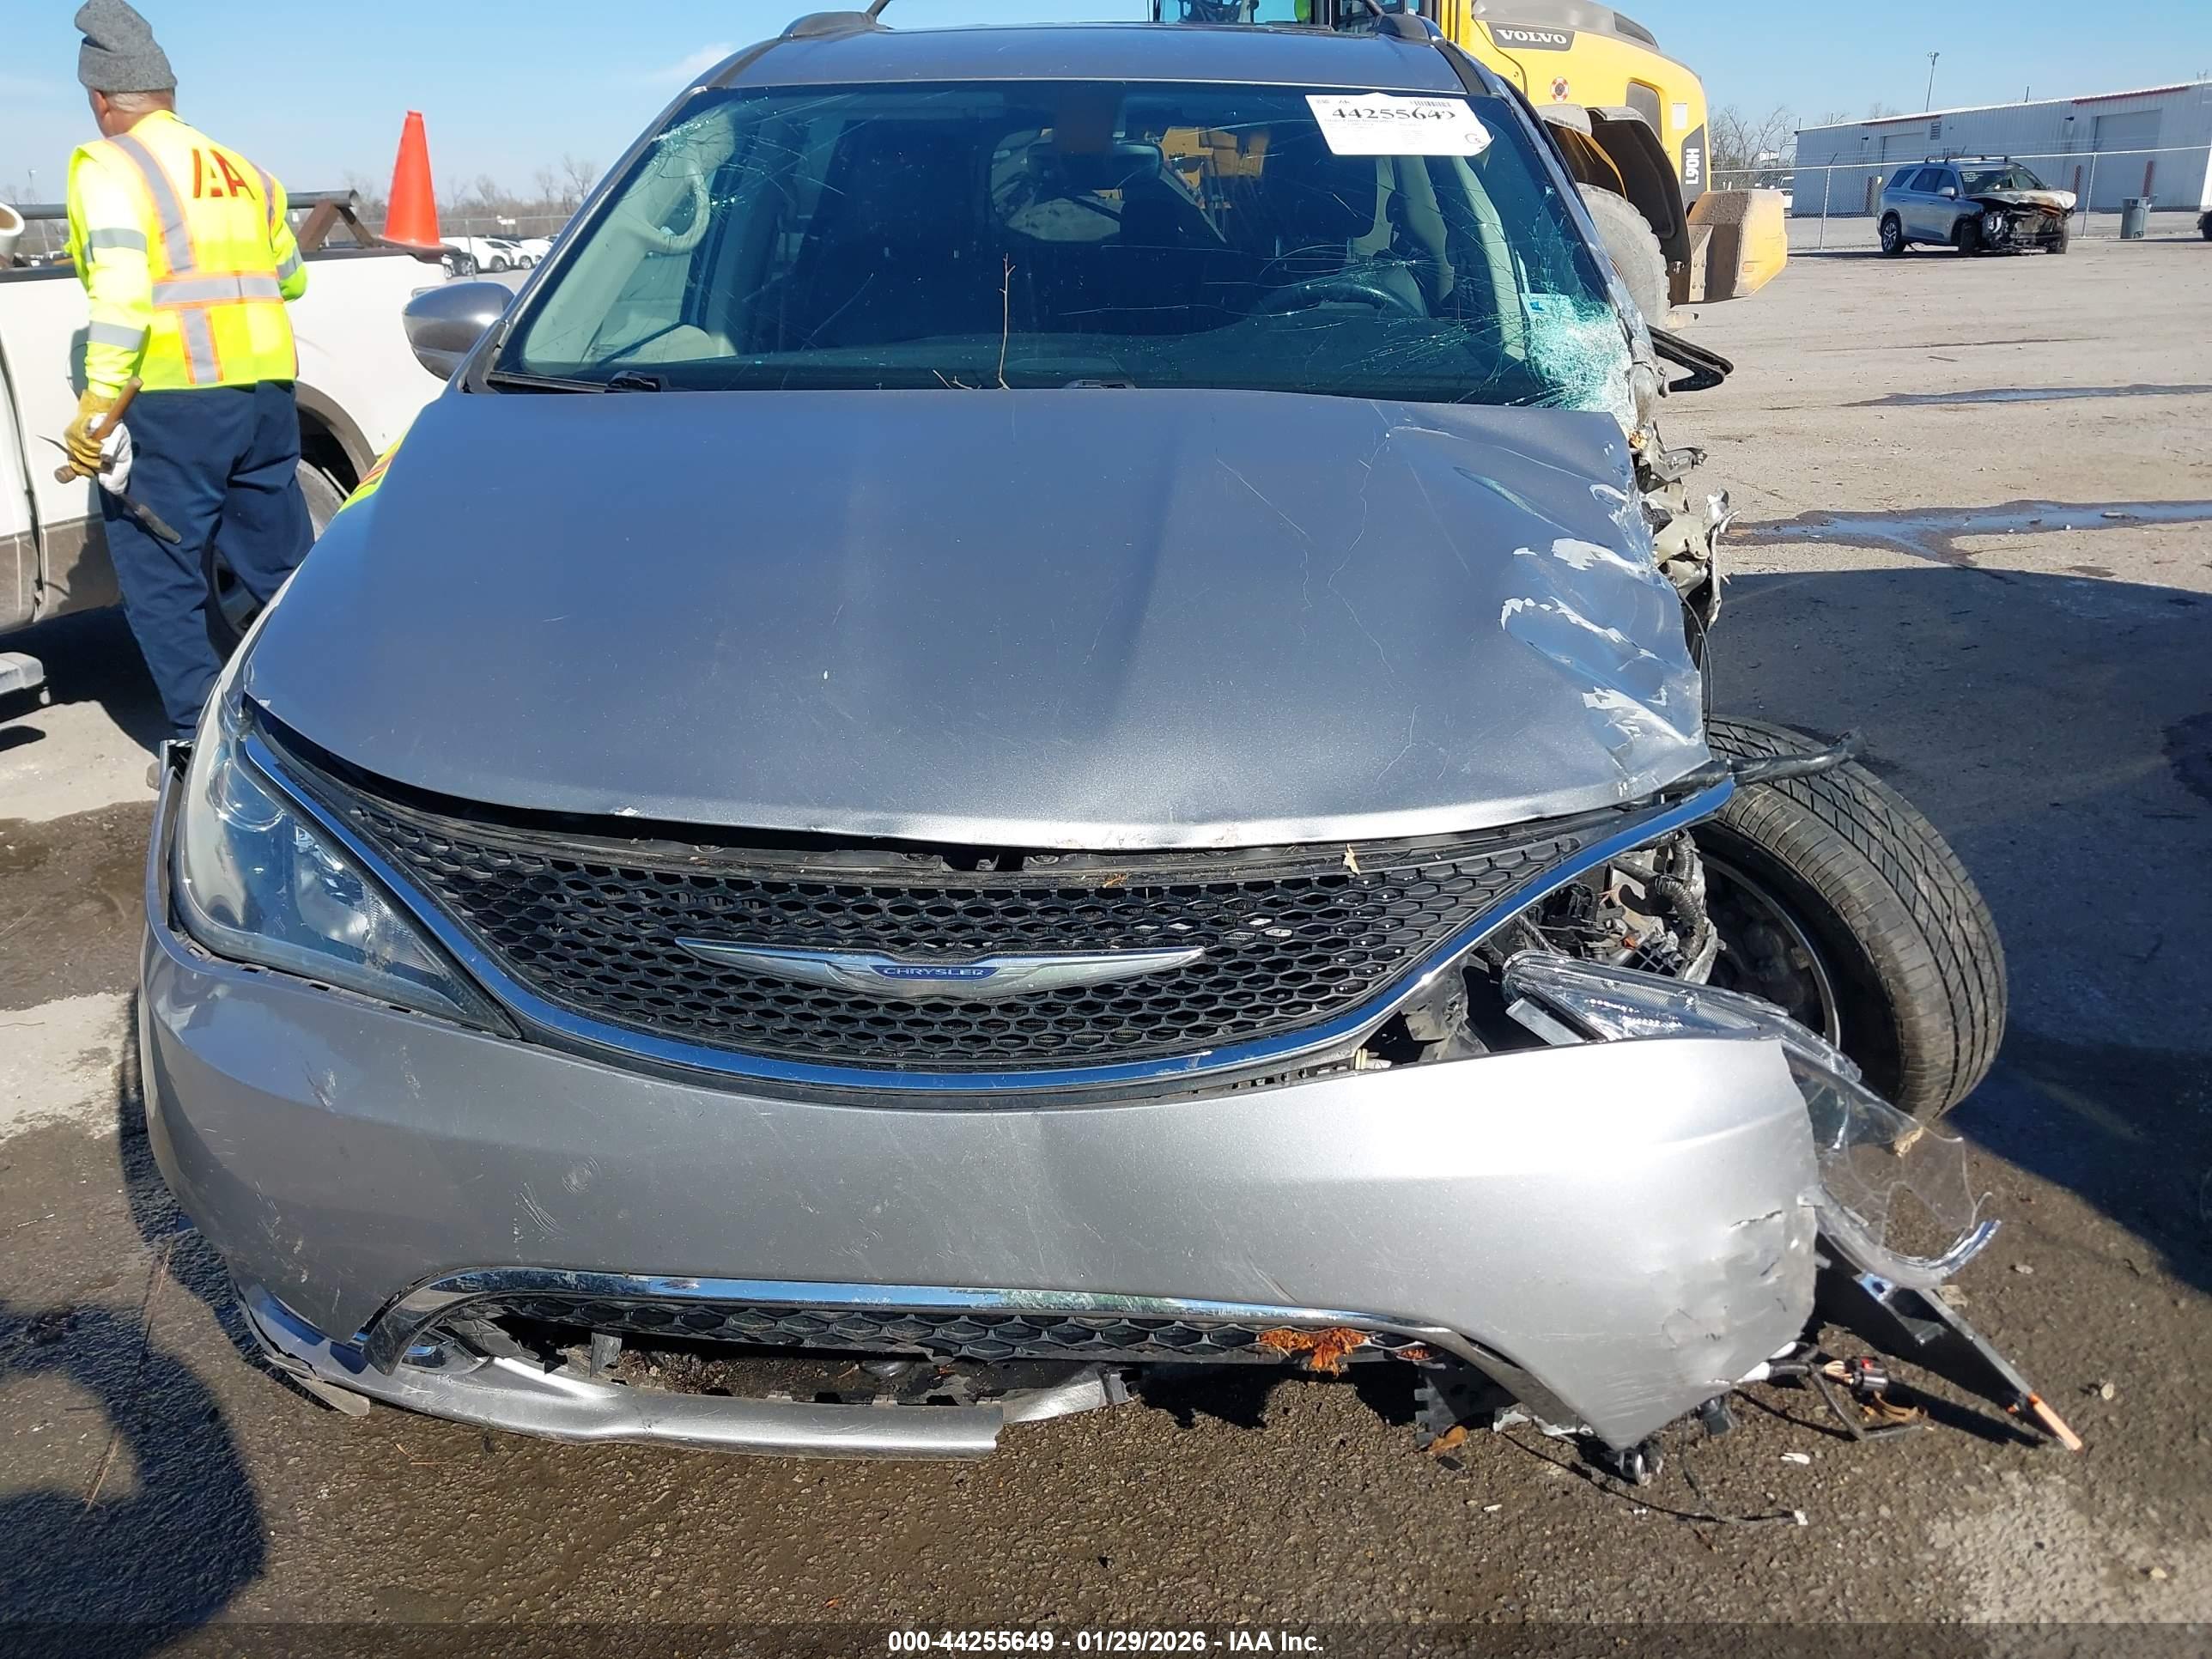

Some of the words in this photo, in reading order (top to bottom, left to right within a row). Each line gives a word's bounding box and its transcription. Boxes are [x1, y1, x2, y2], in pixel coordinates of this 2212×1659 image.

[1496, 29, 1567, 45] VOLVO
[1685, 148, 1700, 185] L90H
[884, 967, 985, 975] CHRYSLER
